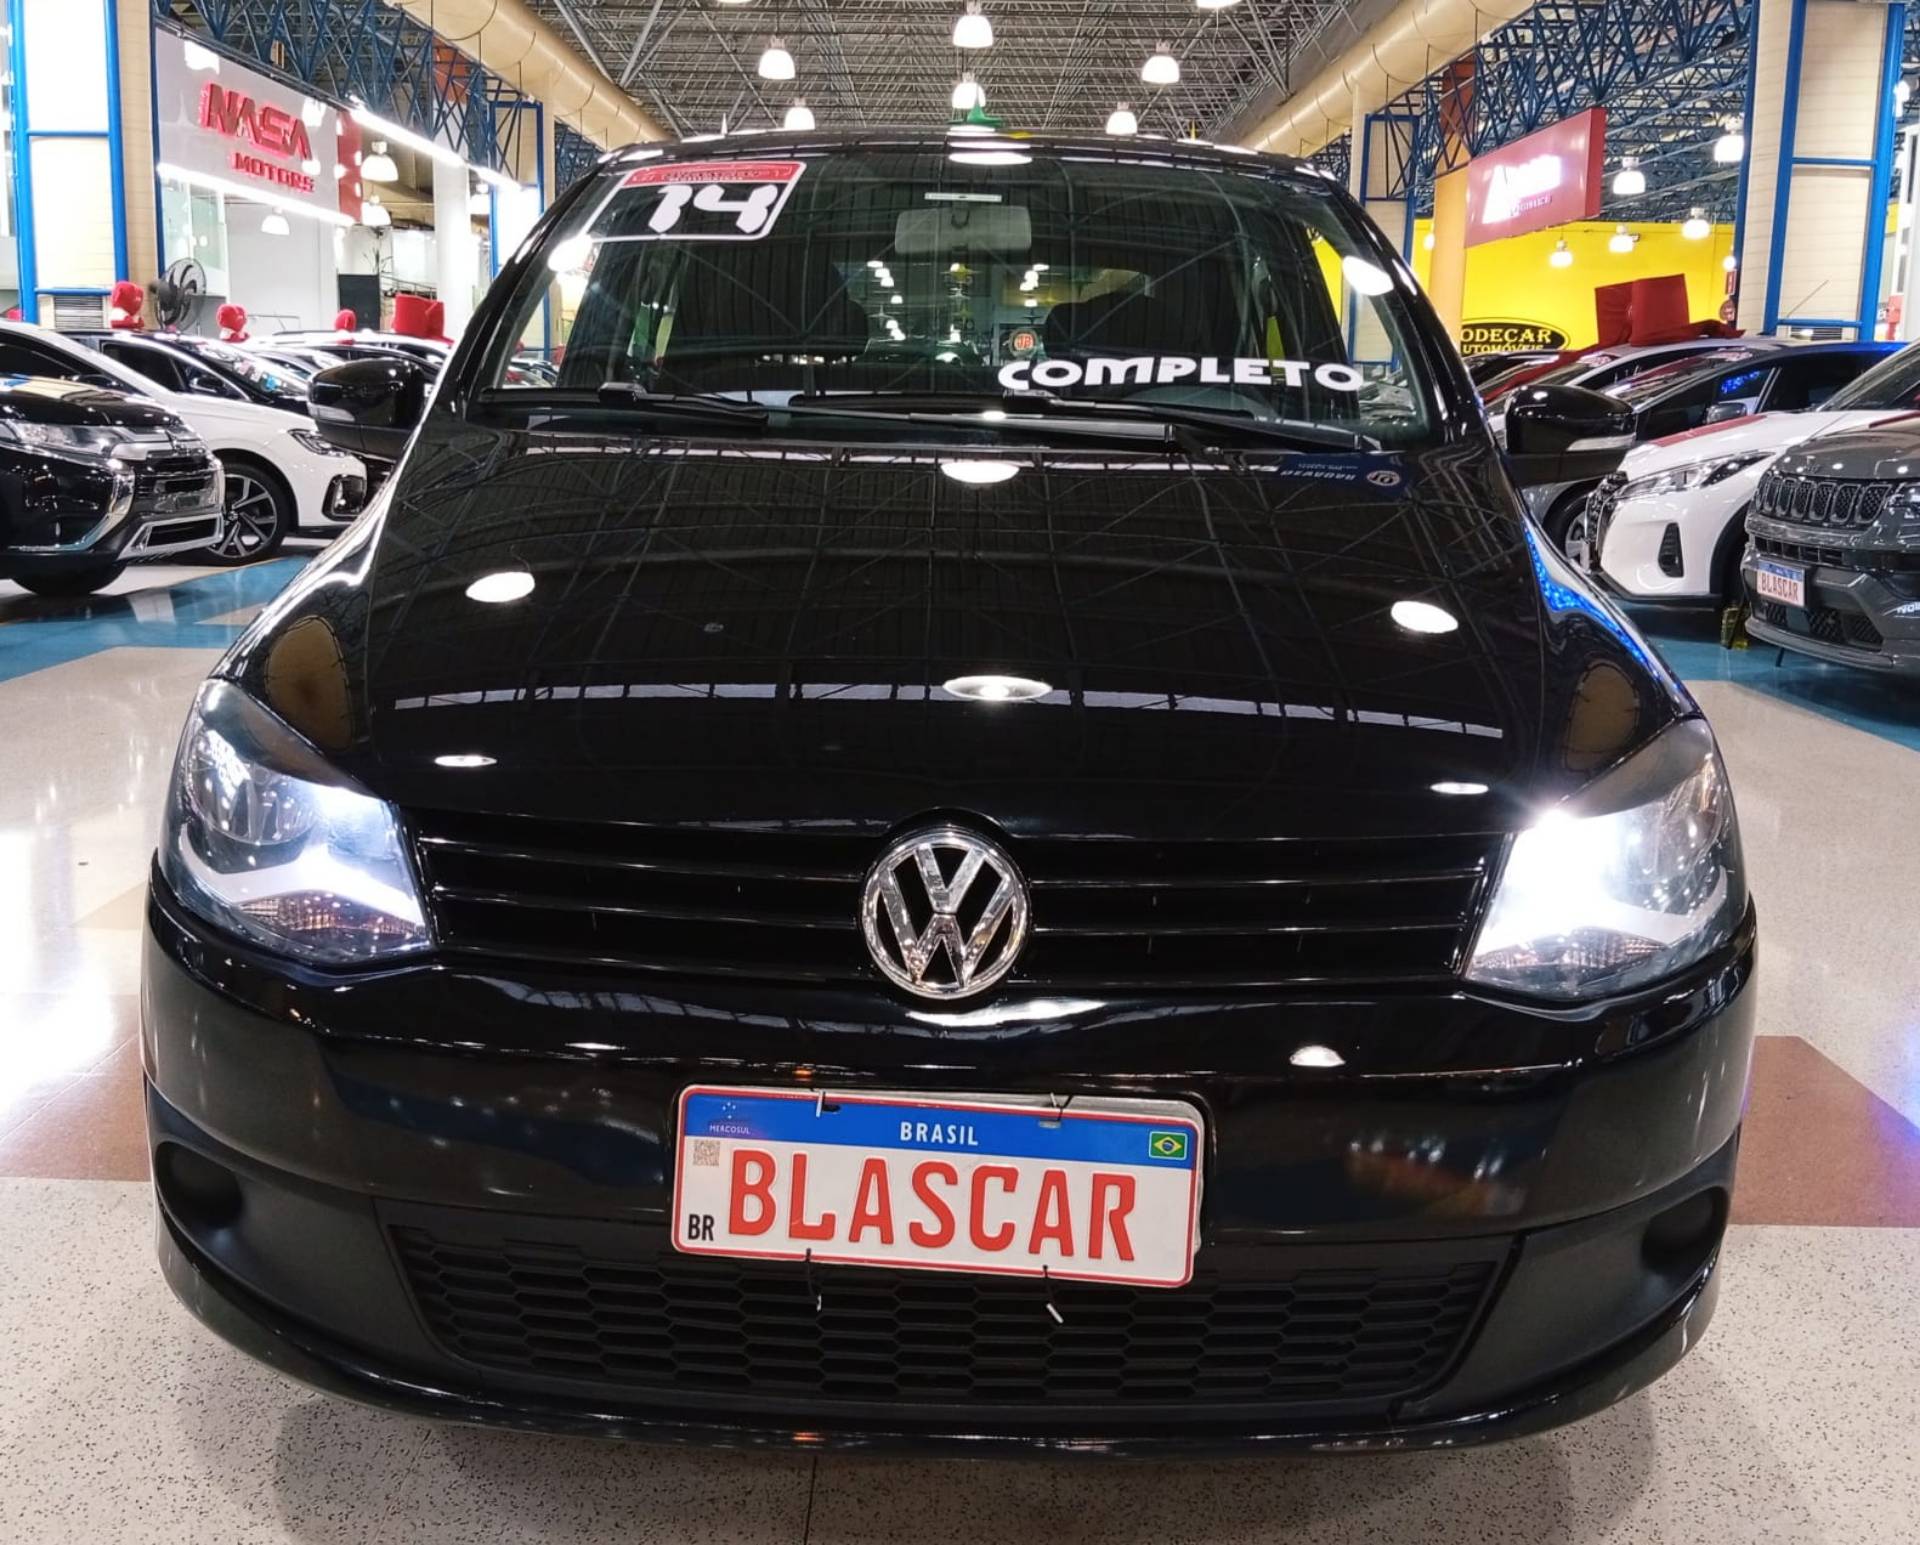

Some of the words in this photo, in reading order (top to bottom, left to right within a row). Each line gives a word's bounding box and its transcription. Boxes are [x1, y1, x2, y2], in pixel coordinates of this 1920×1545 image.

[201, 82, 313, 160] NASA
[233, 152, 315, 193] MOTORS
[648, 184, 779, 234] 14
[1461, 328, 1552, 344] ODECAR
[998, 357, 1364, 392] COMPLETO
[1761, 572, 1799, 600] BLASCAR
[709, 1124, 751, 1135] MERCOSUL
[900, 1121, 979, 1146] BRASIL
[729, 1150, 1136, 1262] BLASCAR
[688, 1213, 715, 1241] BR
